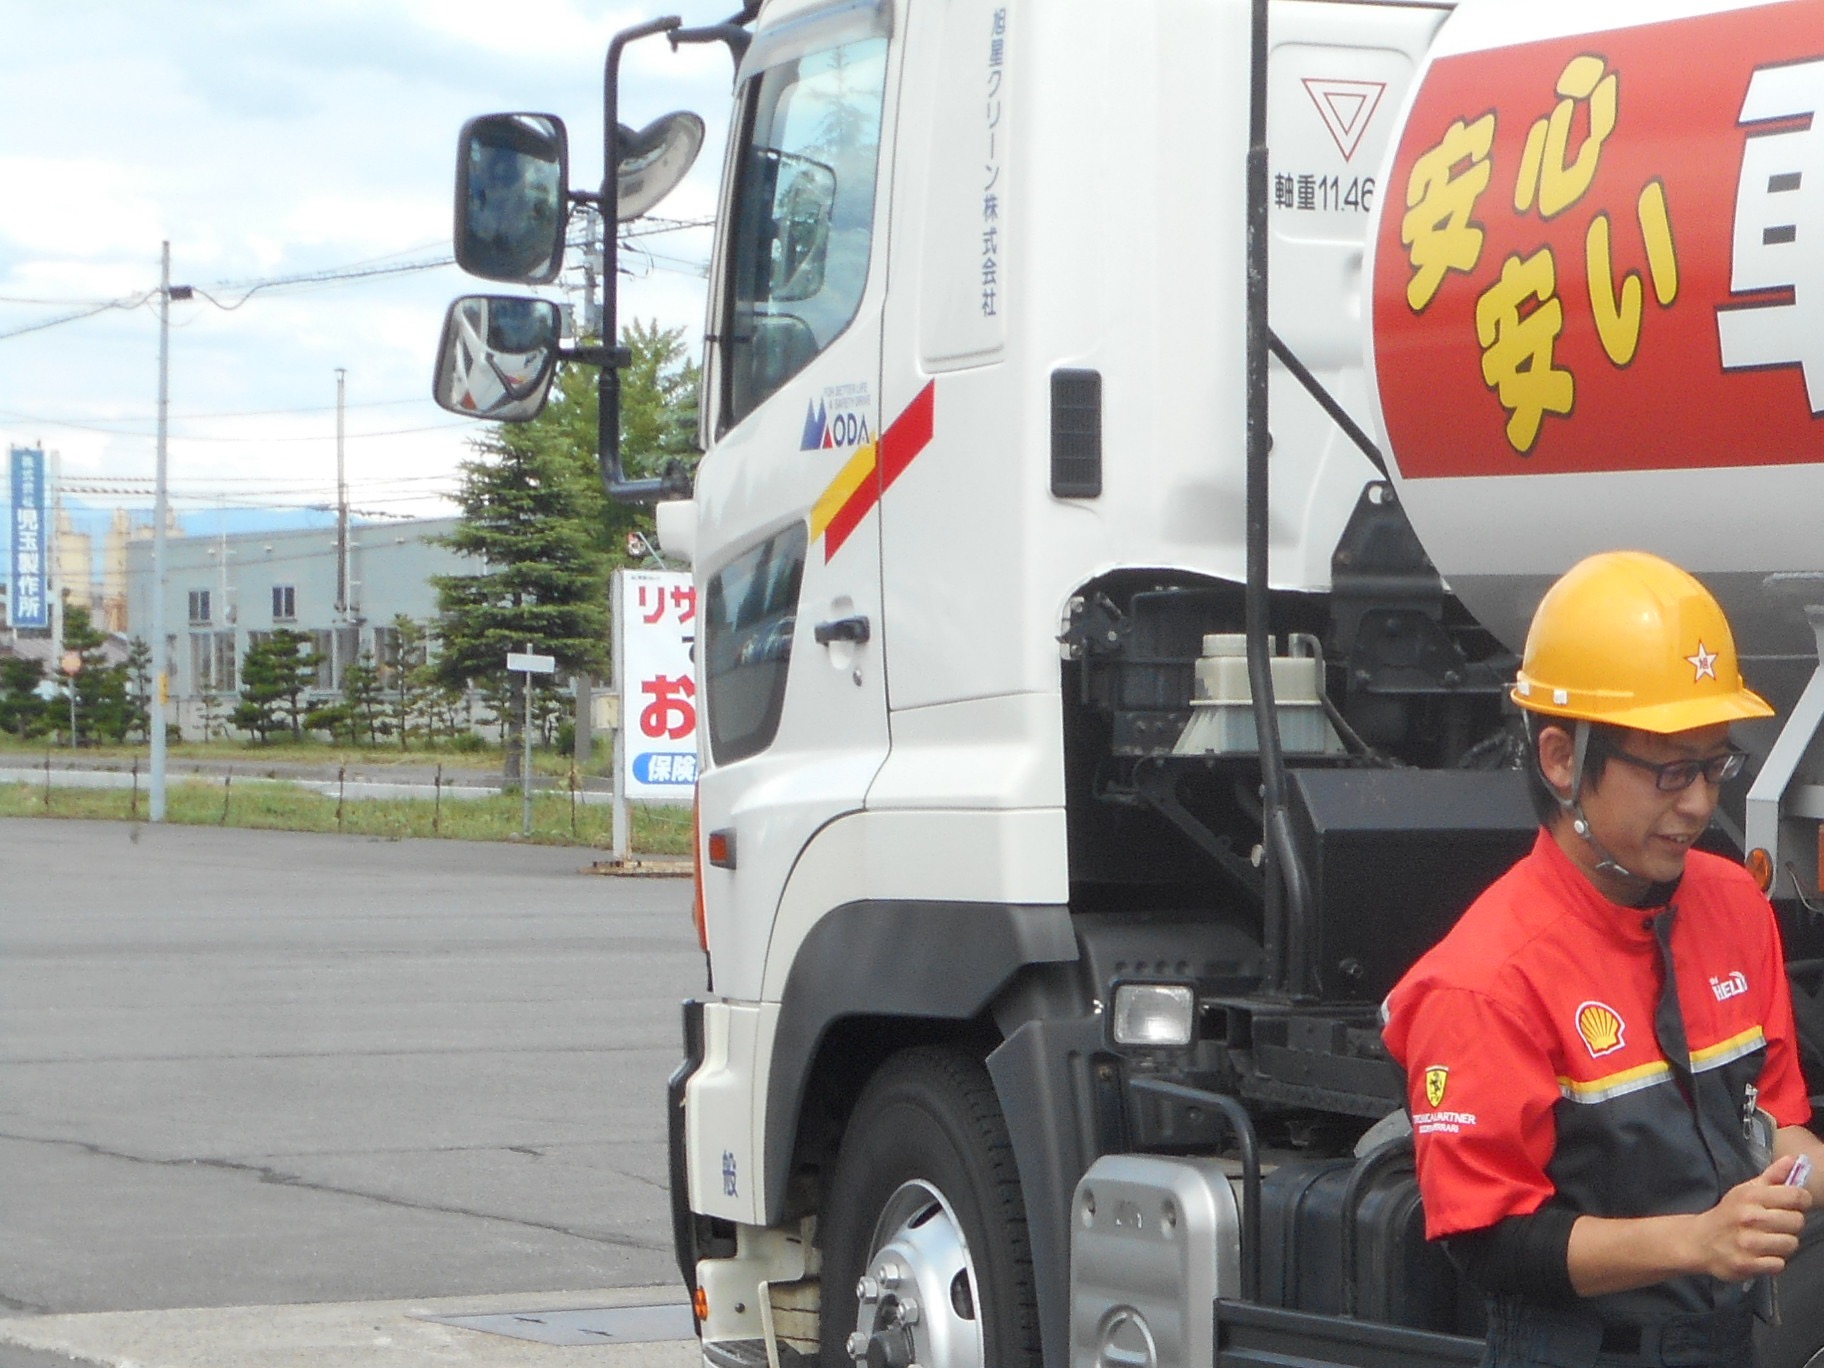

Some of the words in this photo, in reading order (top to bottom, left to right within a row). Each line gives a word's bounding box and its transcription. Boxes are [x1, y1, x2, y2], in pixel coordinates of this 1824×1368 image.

[1401, 52, 1620, 314] 安心
[1474, 176, 1680, 457] 安い
[16, 508, 41, 618] 児玉製作所
